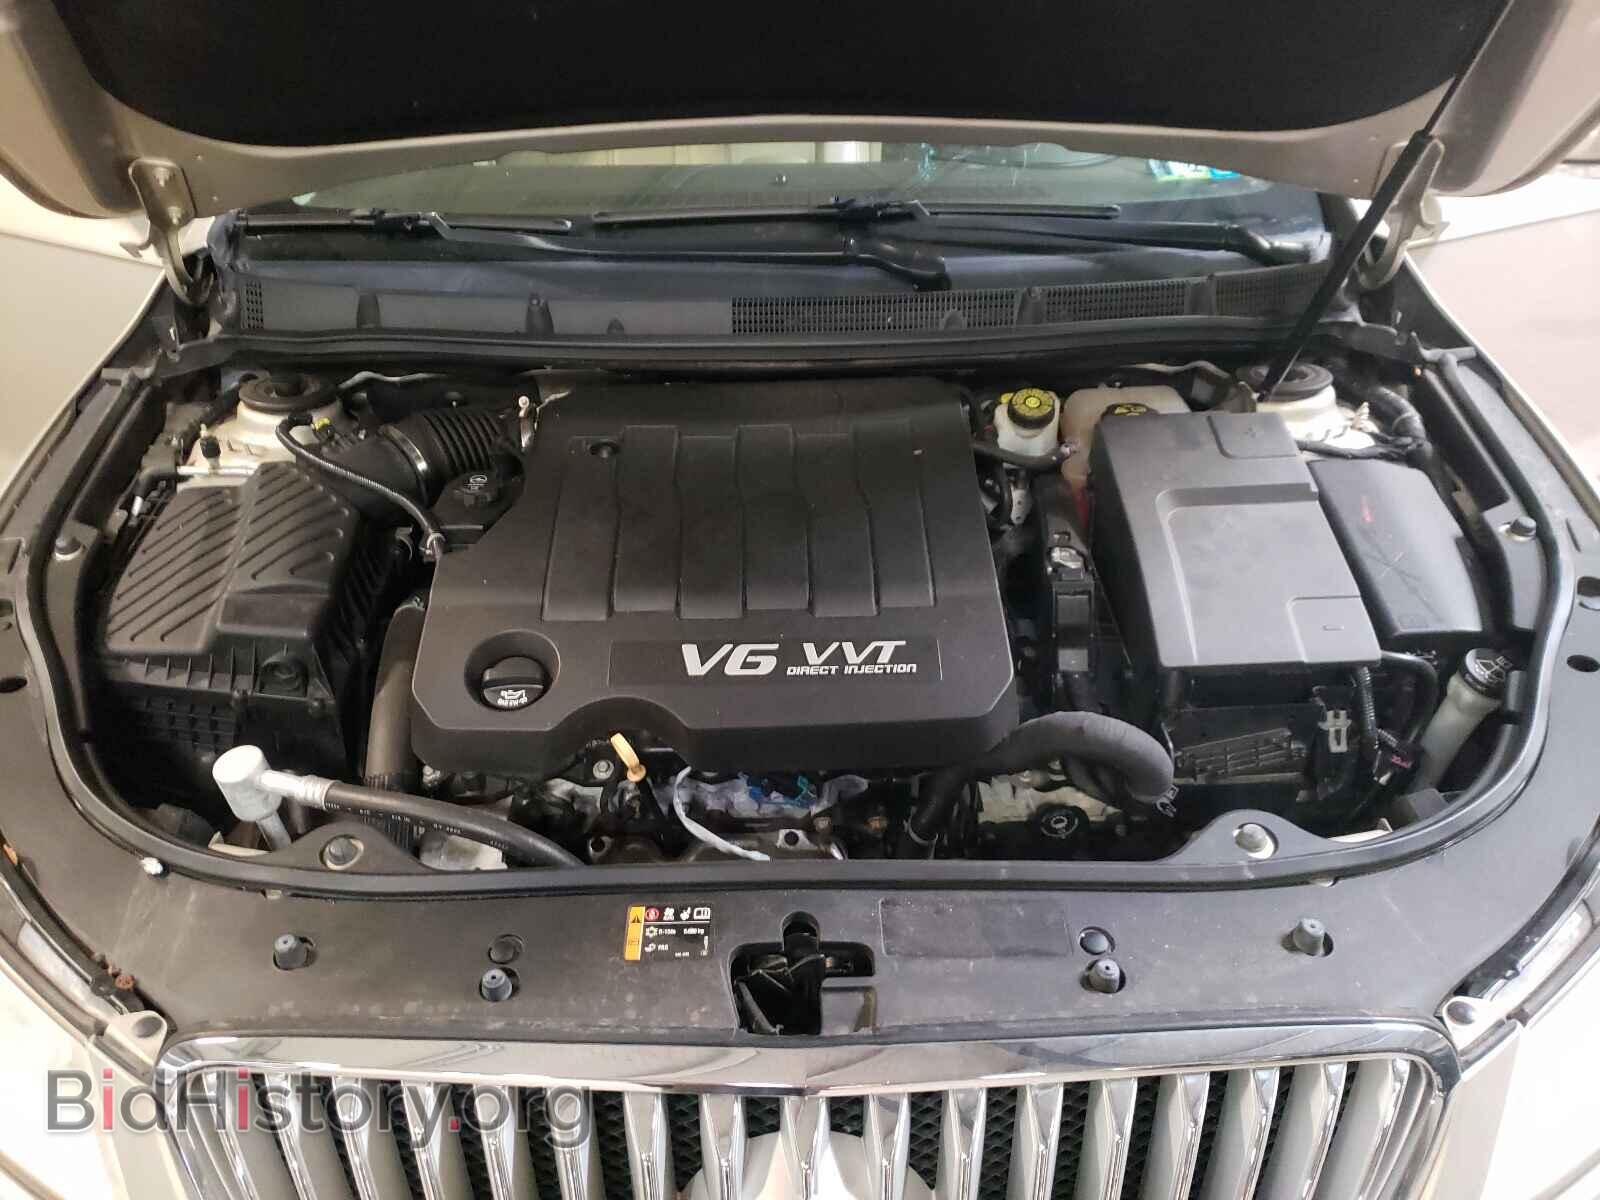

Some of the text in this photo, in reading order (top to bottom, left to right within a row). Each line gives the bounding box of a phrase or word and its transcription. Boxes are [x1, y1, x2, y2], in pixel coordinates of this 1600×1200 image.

[681, 641, 906, 676] V6 VVT
[787, 664, 917, 676] DIRECT INJECTION
